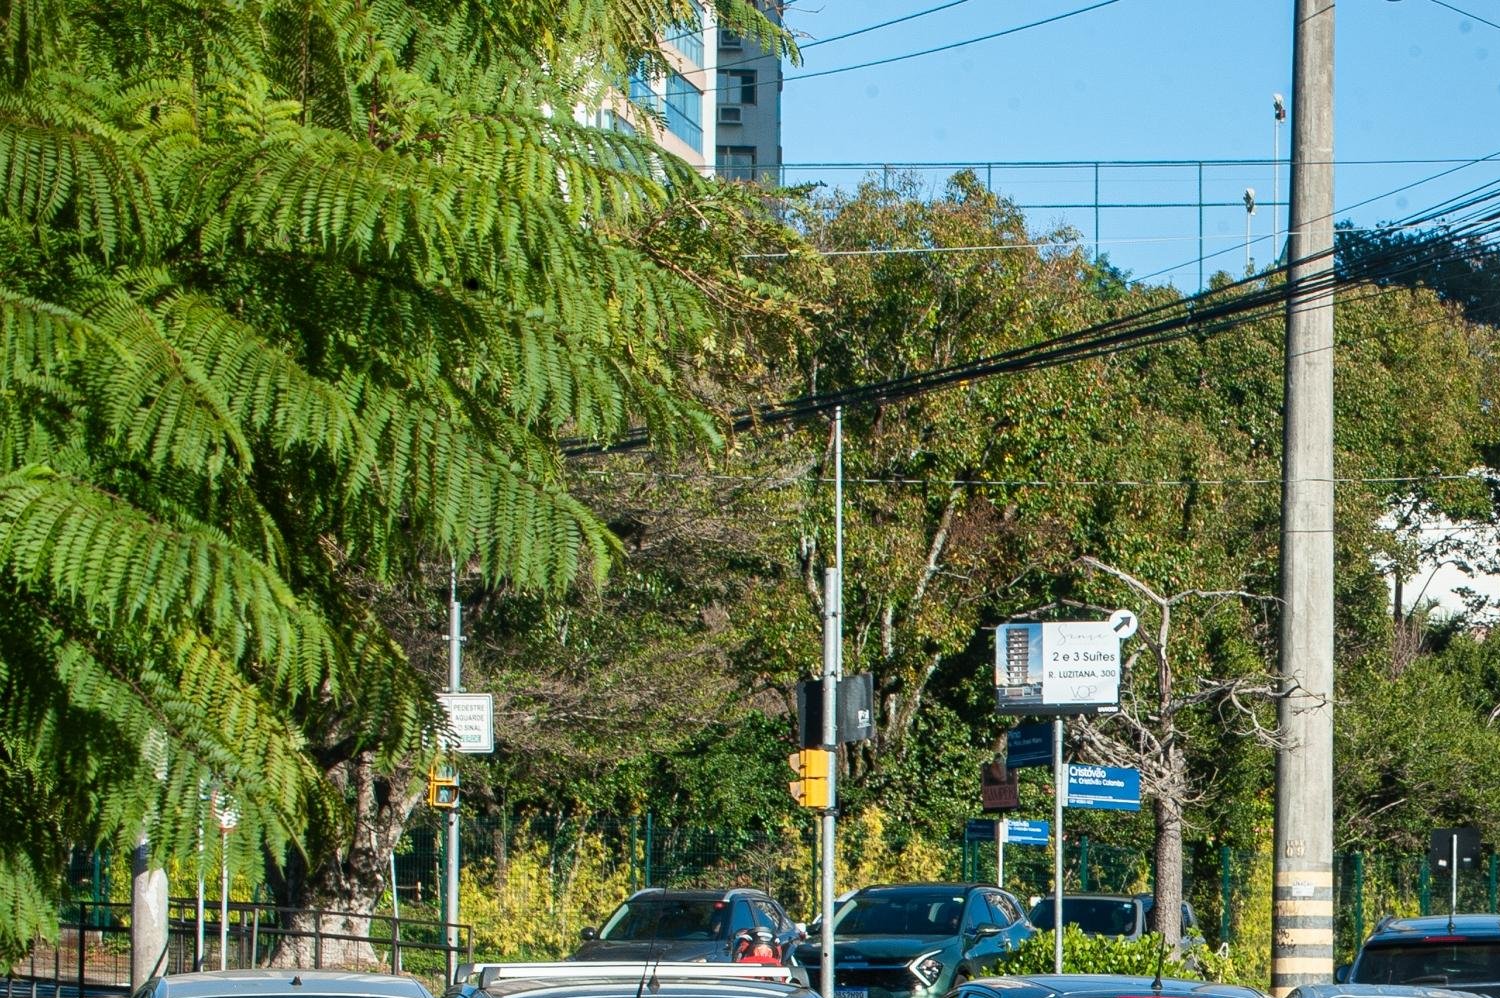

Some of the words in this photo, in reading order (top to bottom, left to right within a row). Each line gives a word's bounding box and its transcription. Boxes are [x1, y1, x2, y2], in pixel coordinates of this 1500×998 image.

[1052, 651, 1059, 662] 2
[1062, 653, 1070, 662] e
[1073, 651, 1080, 662] 3
[1100, 669, 1116, 678] 300
[1070, 685, 1098, 699] VOP
[1069, 766, 1107, 779] Cristóvão
